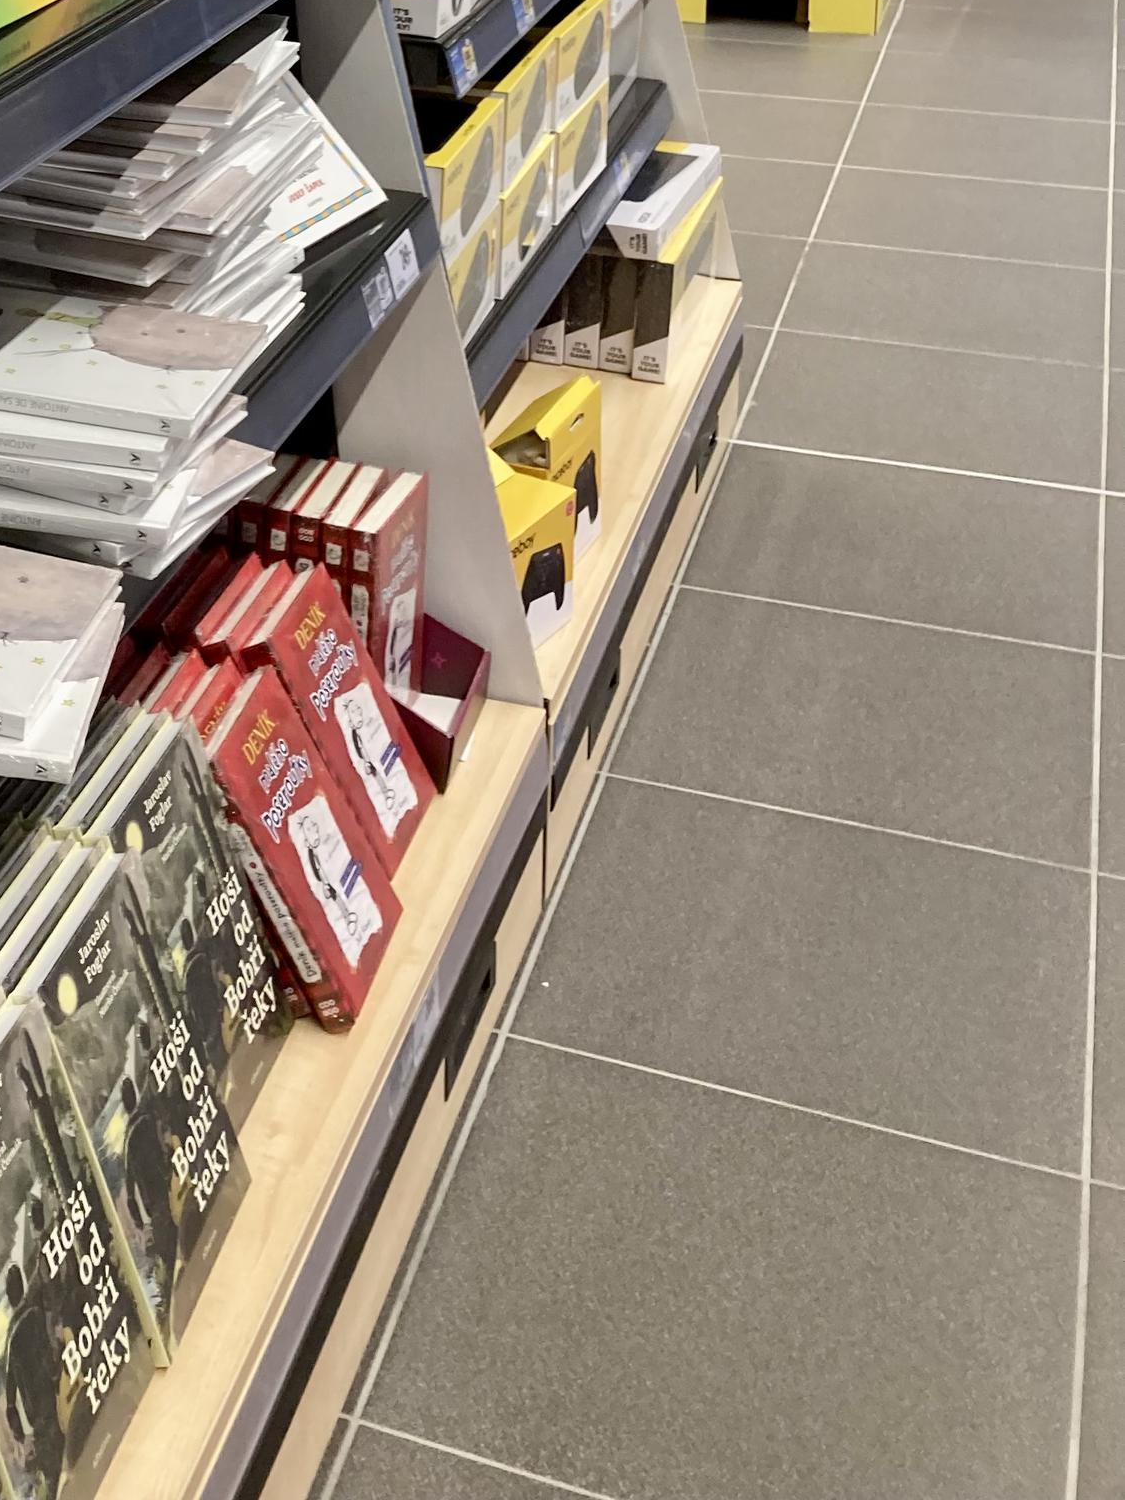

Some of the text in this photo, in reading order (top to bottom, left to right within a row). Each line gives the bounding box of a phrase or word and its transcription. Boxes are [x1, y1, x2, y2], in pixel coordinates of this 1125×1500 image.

[294, 601, 327, 650] DENÍK
[241, 708, 277, 766] DENÍK
[143, 769, 173, 815] Jaroslav
[148, 796, 173, 833] Foglar
[204, 865, 244, 937] Hoši
[233, 899, 255, 947] od
[77, 910, 112, 966] Jaroslav
[83, 938, 113, 985] Foglar
[223, 934, 268, 1020] Bobří
[242, 975, 278, 1045] řeky
[150, 1010, 192, 1094] Hoši
[180, 1048, 205, 1102] od
[170, 1084, 220, 1187] Bobří
[190, 1131, 232, 1214] řeky
[40, 1180, 93, 1280] Hoši
[78, 1223, 107, 1288] od
[60, 1265, 122, 1382] Bobří
[83, 1316, 132, 1415] řeky
